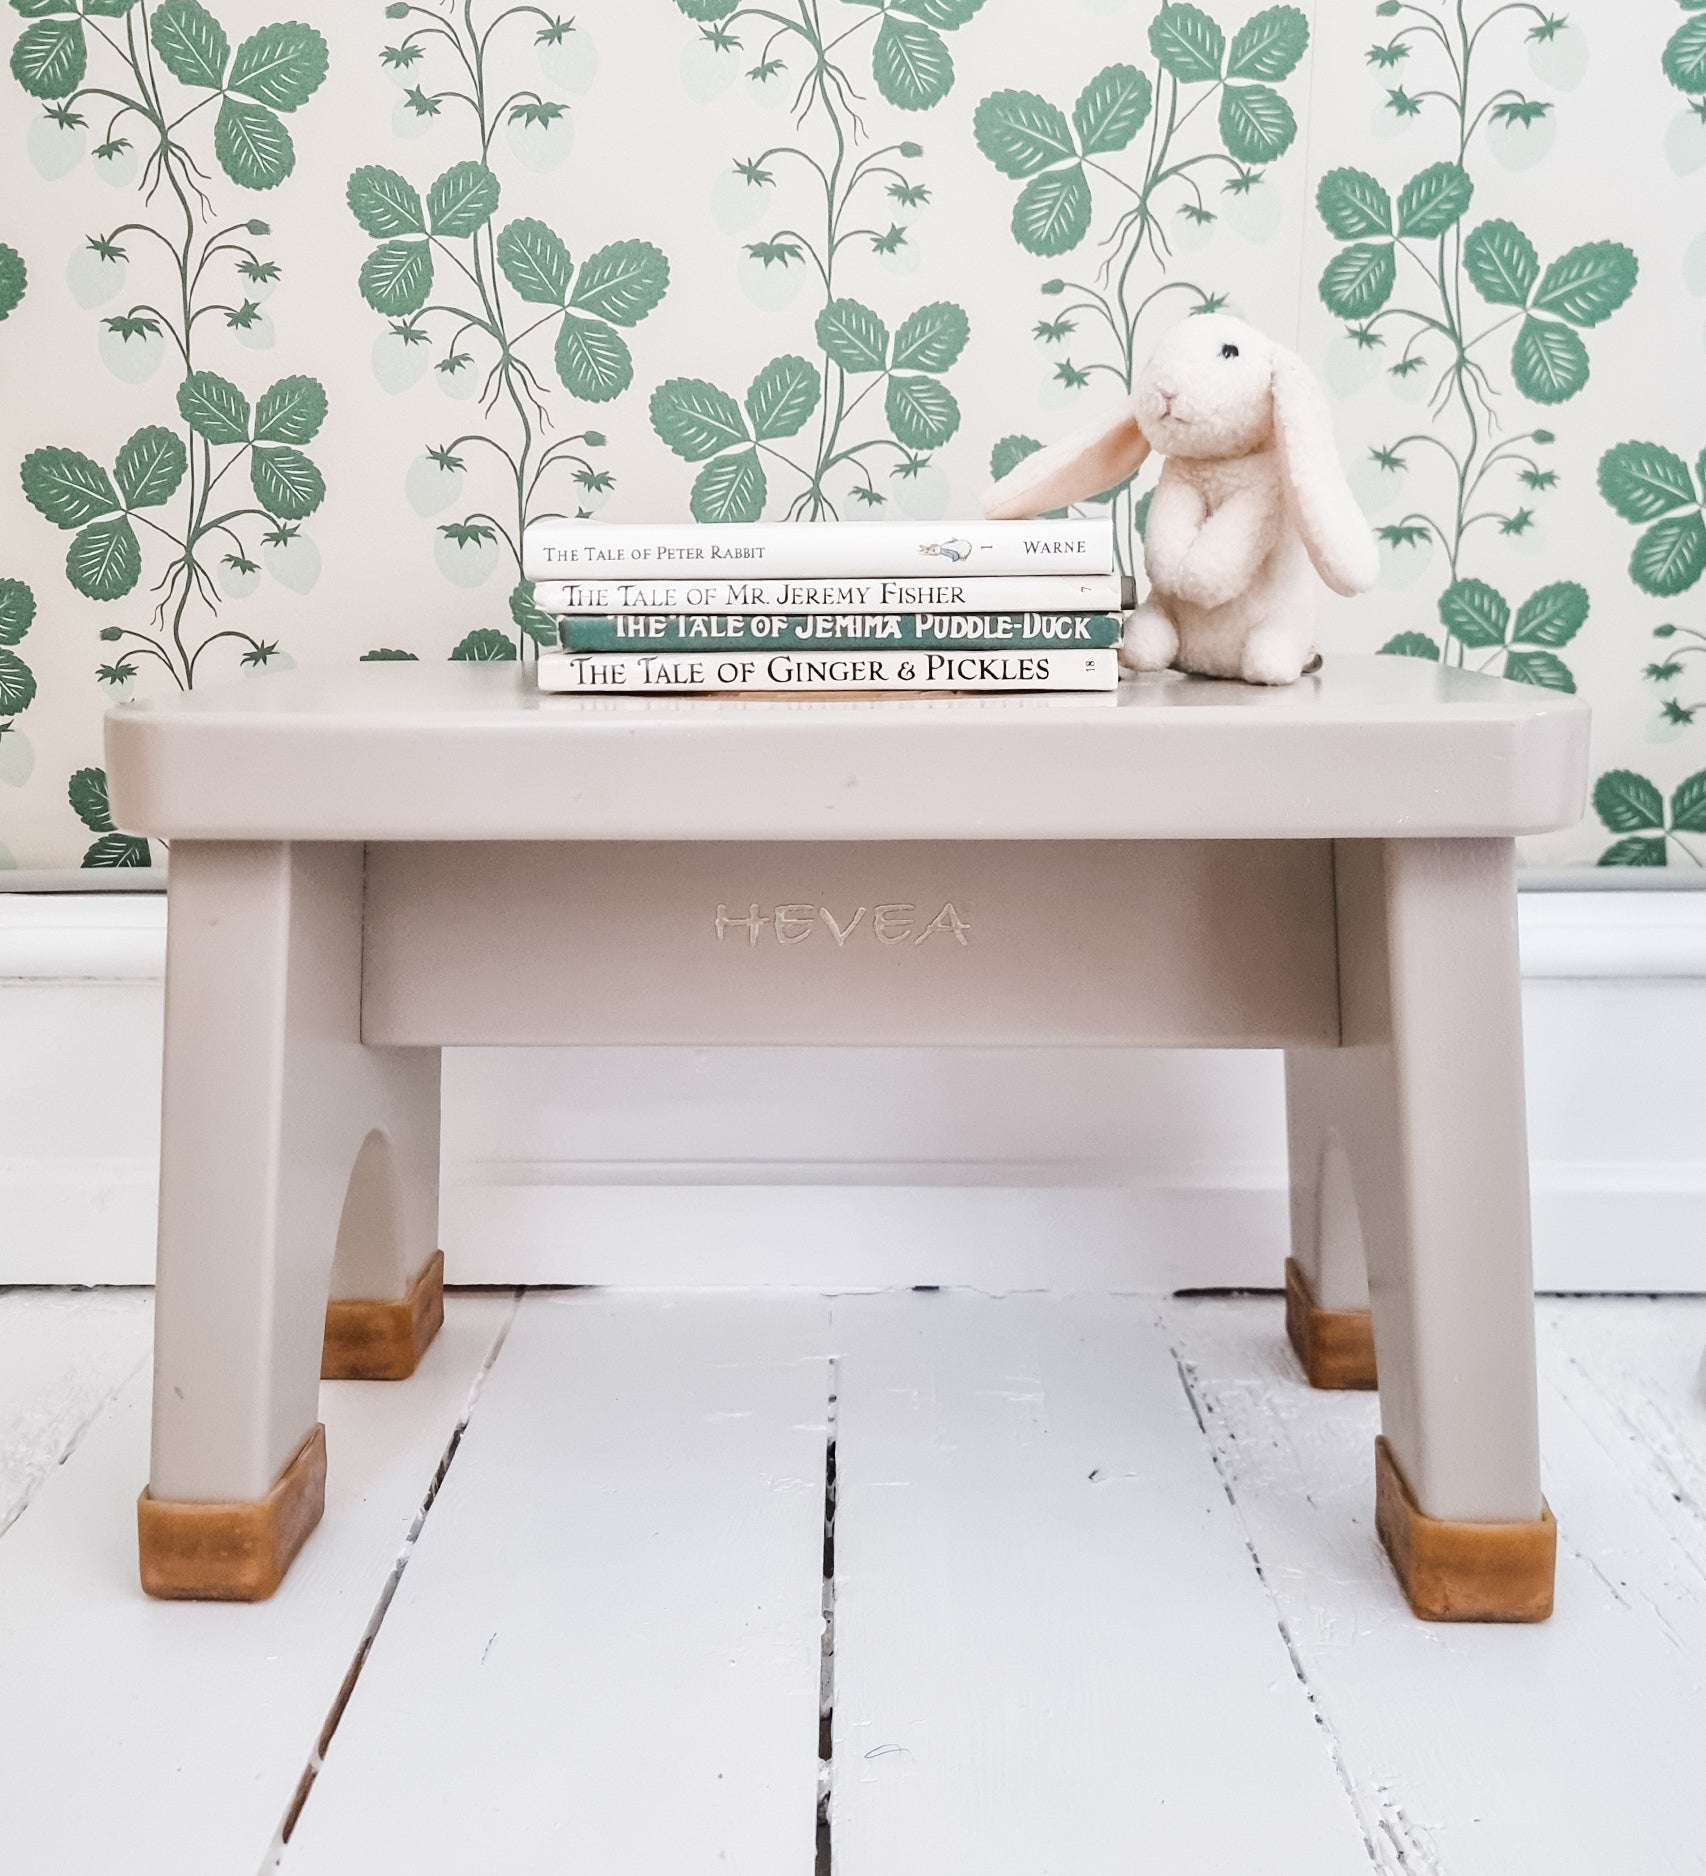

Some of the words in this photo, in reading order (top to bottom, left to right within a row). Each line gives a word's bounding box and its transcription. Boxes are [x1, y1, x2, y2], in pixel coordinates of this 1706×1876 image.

[543, 547, 579, 562] THE
[584, 547, 625, 562] TALE
[631, 548, 652, 560] OF
[656, 546, 703, 561] PETER
[710, 545, 766, 560] RABBIT
[1023, 540, 1086, 555] WARNE
[562, 584, 609, 607] THE
[617, 584, 677, 607] TALE
[686, 587, 718, 605] OF
[725, 583, 770, 605] MR.
[777, 584, 871, 605] JEREMY
[879, 582, 966, 604] FISHER
[1081, 585, 1092, 593] 7
[607, 615, 667, 638] THE
[670, 615, 745, 638] TALE
[751, 615, 788, 638] OF
[795, 614, 902, 639] JEMIMA
[915, 612, 1092, 640] PUDDLE-DUCK
[570, 656, 627, 685] THE
[636, 656, 705, 685] TALE
[717, 661, 756, 684] OF
[767, 655, 889, 683] GINGER
[897, 661, 916, 681] &
[924, 653, 1050, 682] PICKLES
[1085, 660, 1096, 672] 18
[715, 902, 971, 947] HEVEA
